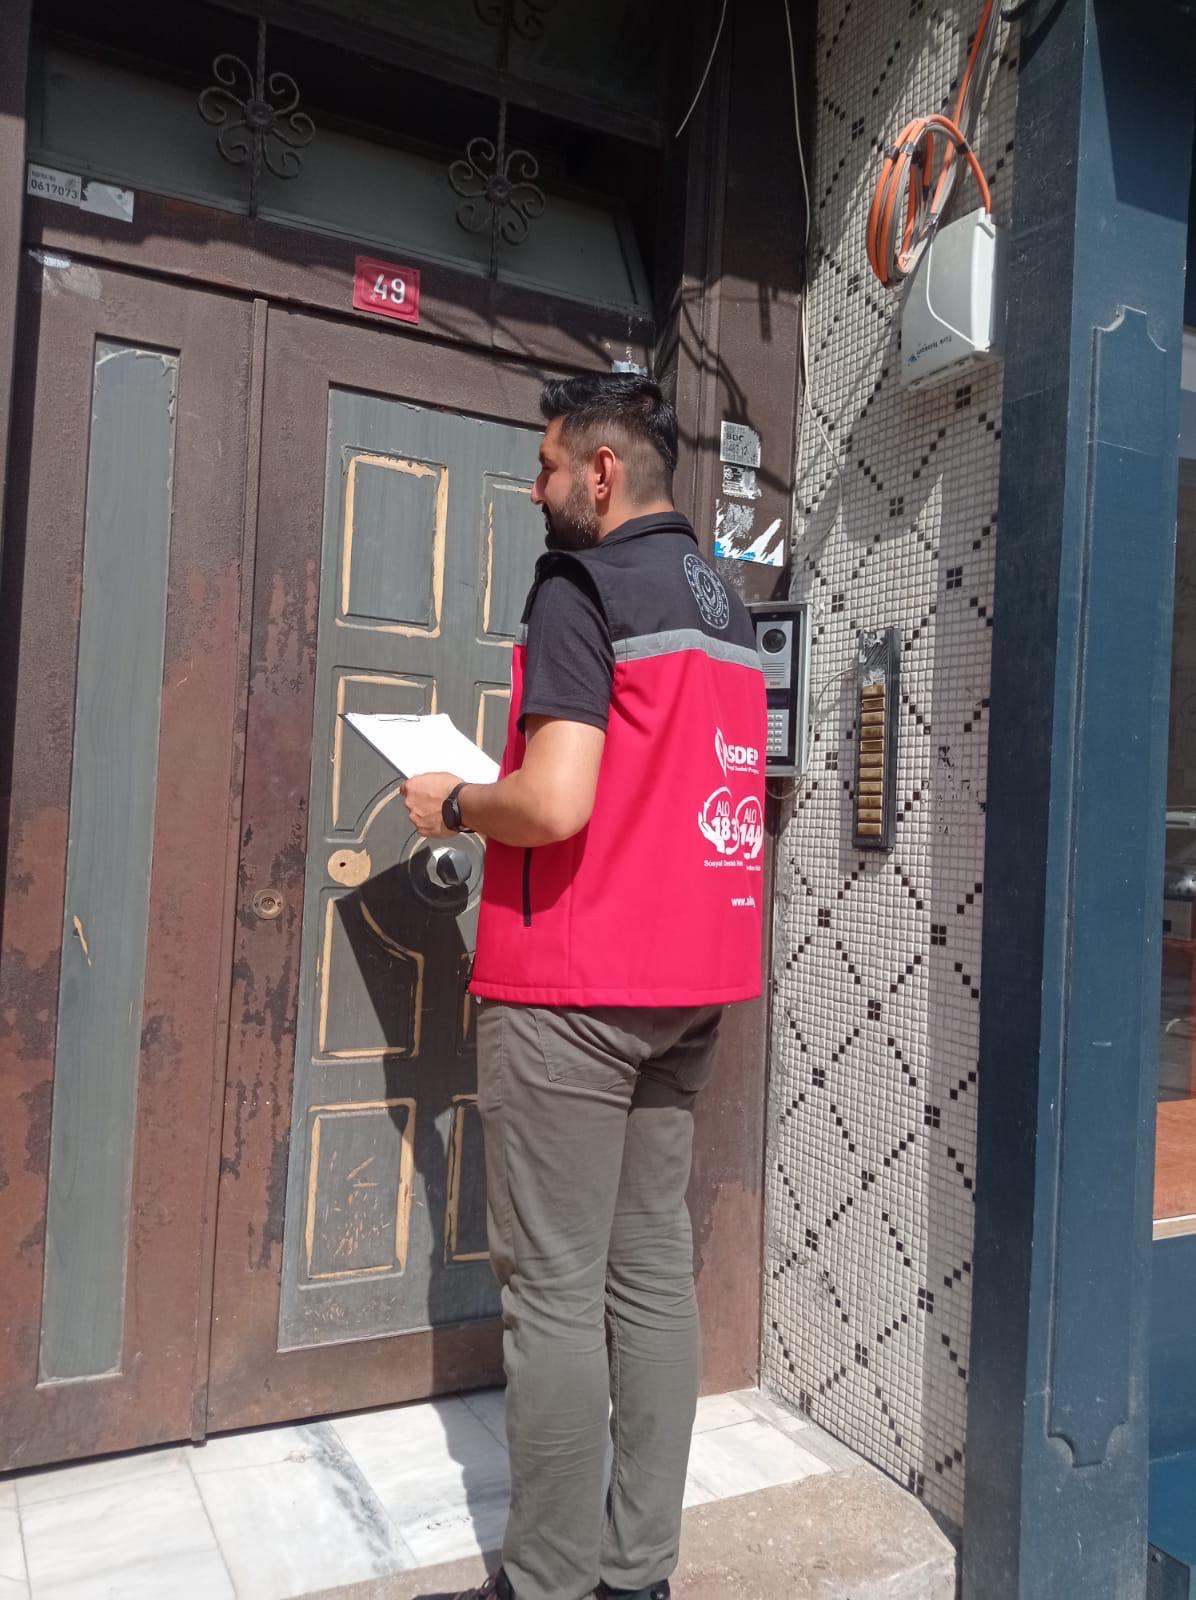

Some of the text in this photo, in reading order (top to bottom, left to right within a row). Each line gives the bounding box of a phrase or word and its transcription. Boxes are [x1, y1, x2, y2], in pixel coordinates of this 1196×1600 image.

[31, 179, 79, 200] 0617073
[373, 273, 406, 304] 49
[715, 800, 730, 817] ALO
[743, 807, 756, 824] ALO
[710, 816, 738, 842] 183
